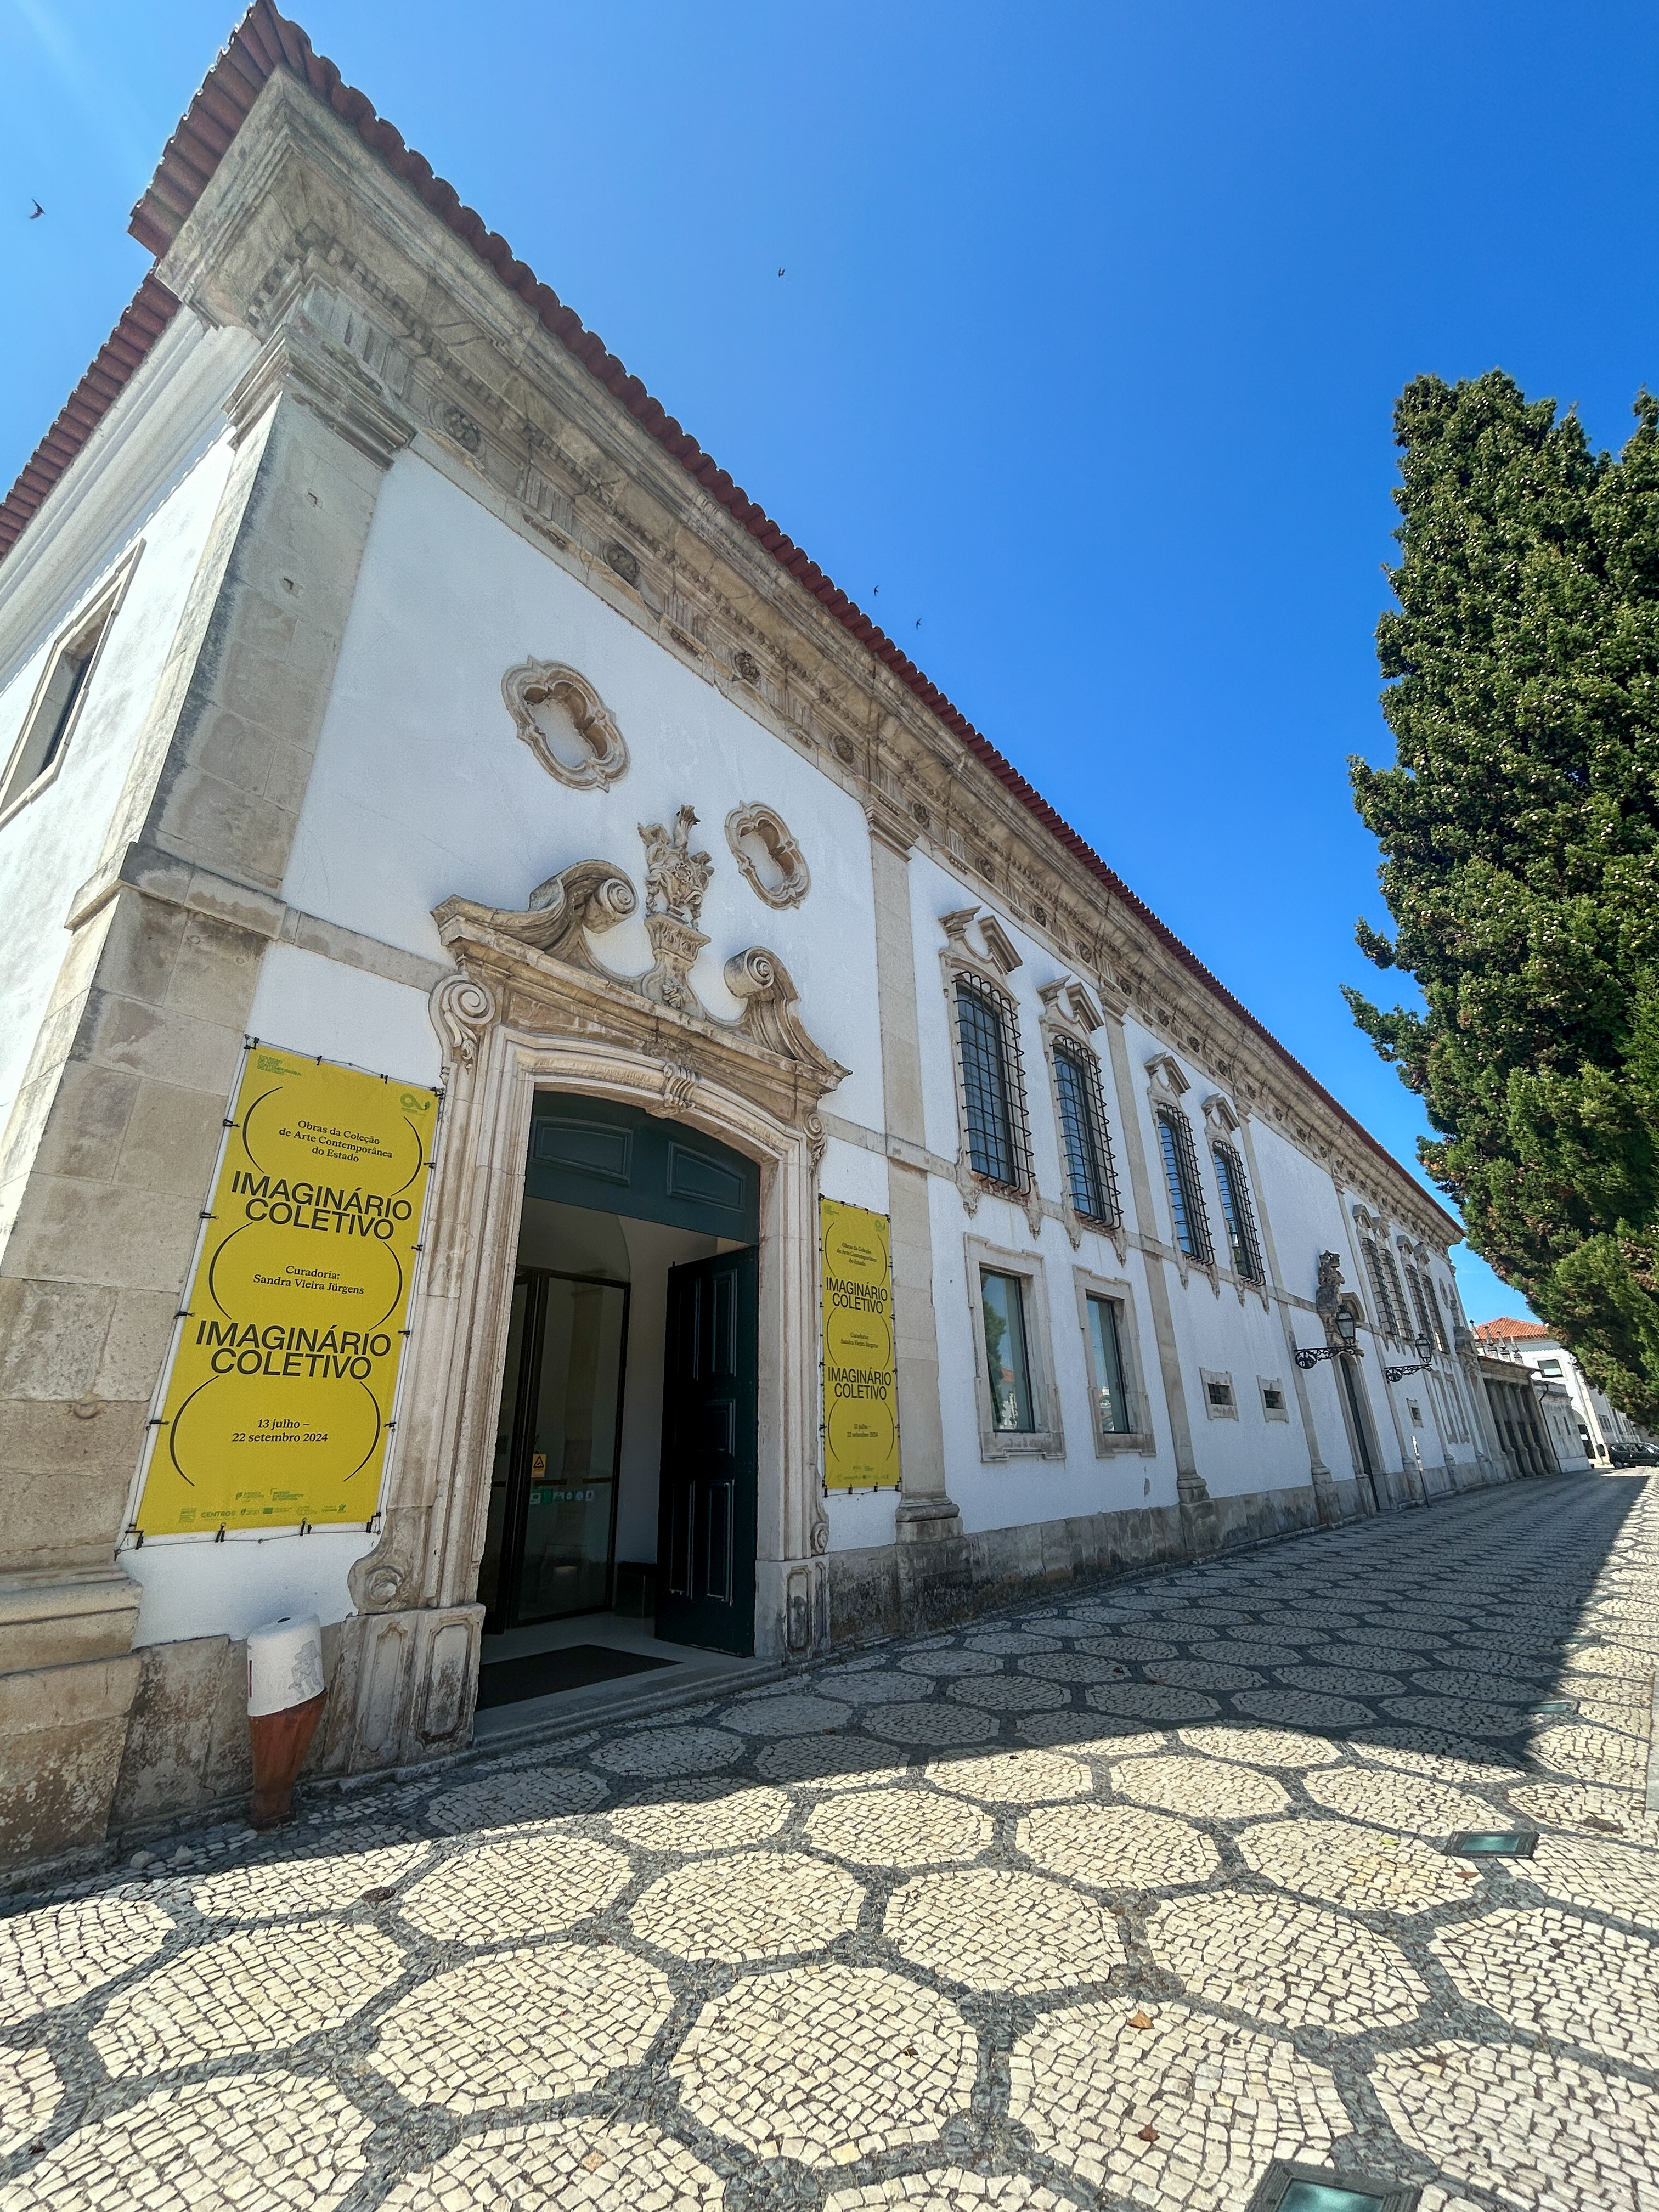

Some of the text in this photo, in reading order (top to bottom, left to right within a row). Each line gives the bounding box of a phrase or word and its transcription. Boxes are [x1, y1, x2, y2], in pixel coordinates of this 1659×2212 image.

[298, 1120, 380, 1144] Obras da Coleção
[279, 1128, 392, 1158] de Arte Contemporânea
[312, 1146, 359, 1162] do Estado
[232, 1171, 412, 1220] IMAGINÁRIO
[245, 1198, 394, 1239] COLETIVO
[285, 1265, 340, 1280] Curadoria:
[253, 1274, 364, 1295] Sandra Vieira Jürgens
[826, 1277, 888, 1301] IMAGINÁRIO
[832, 1293, 883, 1314] COLETIVO
[196, 1320, 391, 1356] IMAGINÁRIO
[211, 1348, 371, 1380] COLETIVO
[828, 1367, 891, 1386] IMAGINÁRIO
[834, 1383, 887, 1400] COLETIVO
[257, 1419, 269, 1428] 13
[270, 1419, 300, 1430] julho
[232, 1432, 328, 1442] 22 setembro 2024
